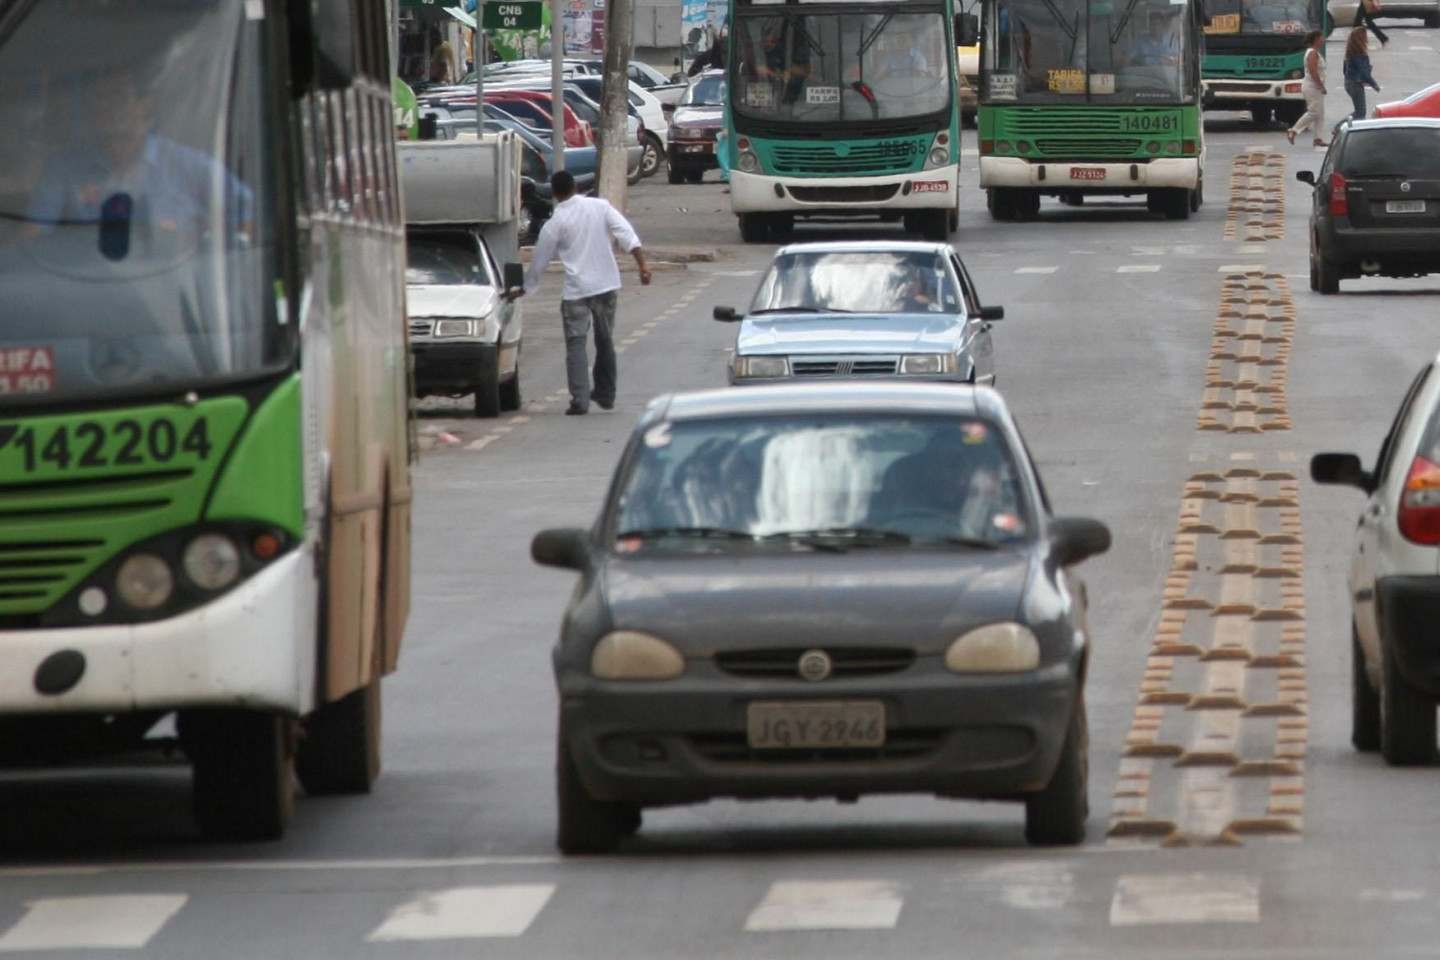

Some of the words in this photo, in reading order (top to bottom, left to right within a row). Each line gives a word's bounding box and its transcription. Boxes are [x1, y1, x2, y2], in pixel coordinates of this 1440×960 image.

[498, 5, 522, 16] CNB
[503, 16, 517, 27] 04
[1123, 115, 1180, 131] 140481
